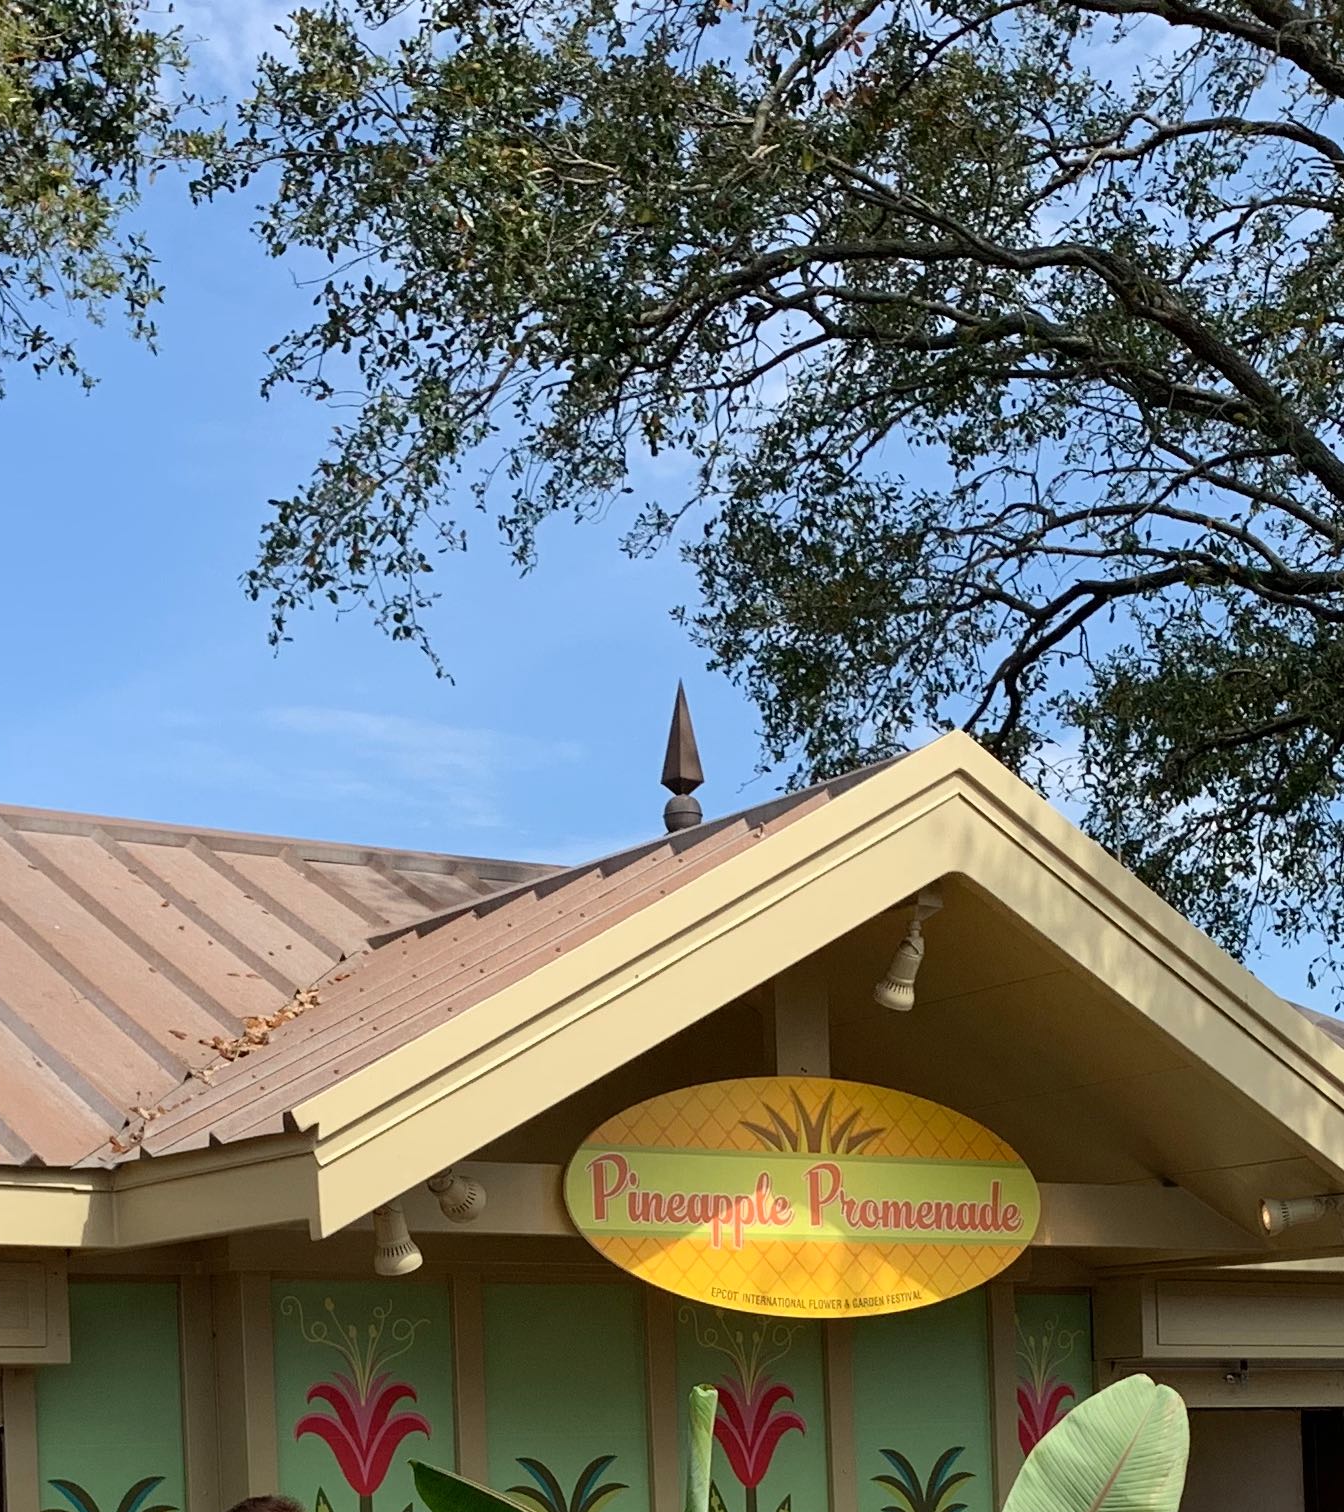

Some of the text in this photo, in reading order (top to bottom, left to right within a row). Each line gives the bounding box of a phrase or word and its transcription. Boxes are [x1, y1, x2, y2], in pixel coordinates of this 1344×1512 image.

[587, 1152, 1024, 1249] Pineapple Promenade
[711, 1287, 922, 1310] EPCOT INTERNATIONAL FLOWER & GARDEN FESTIVAL
